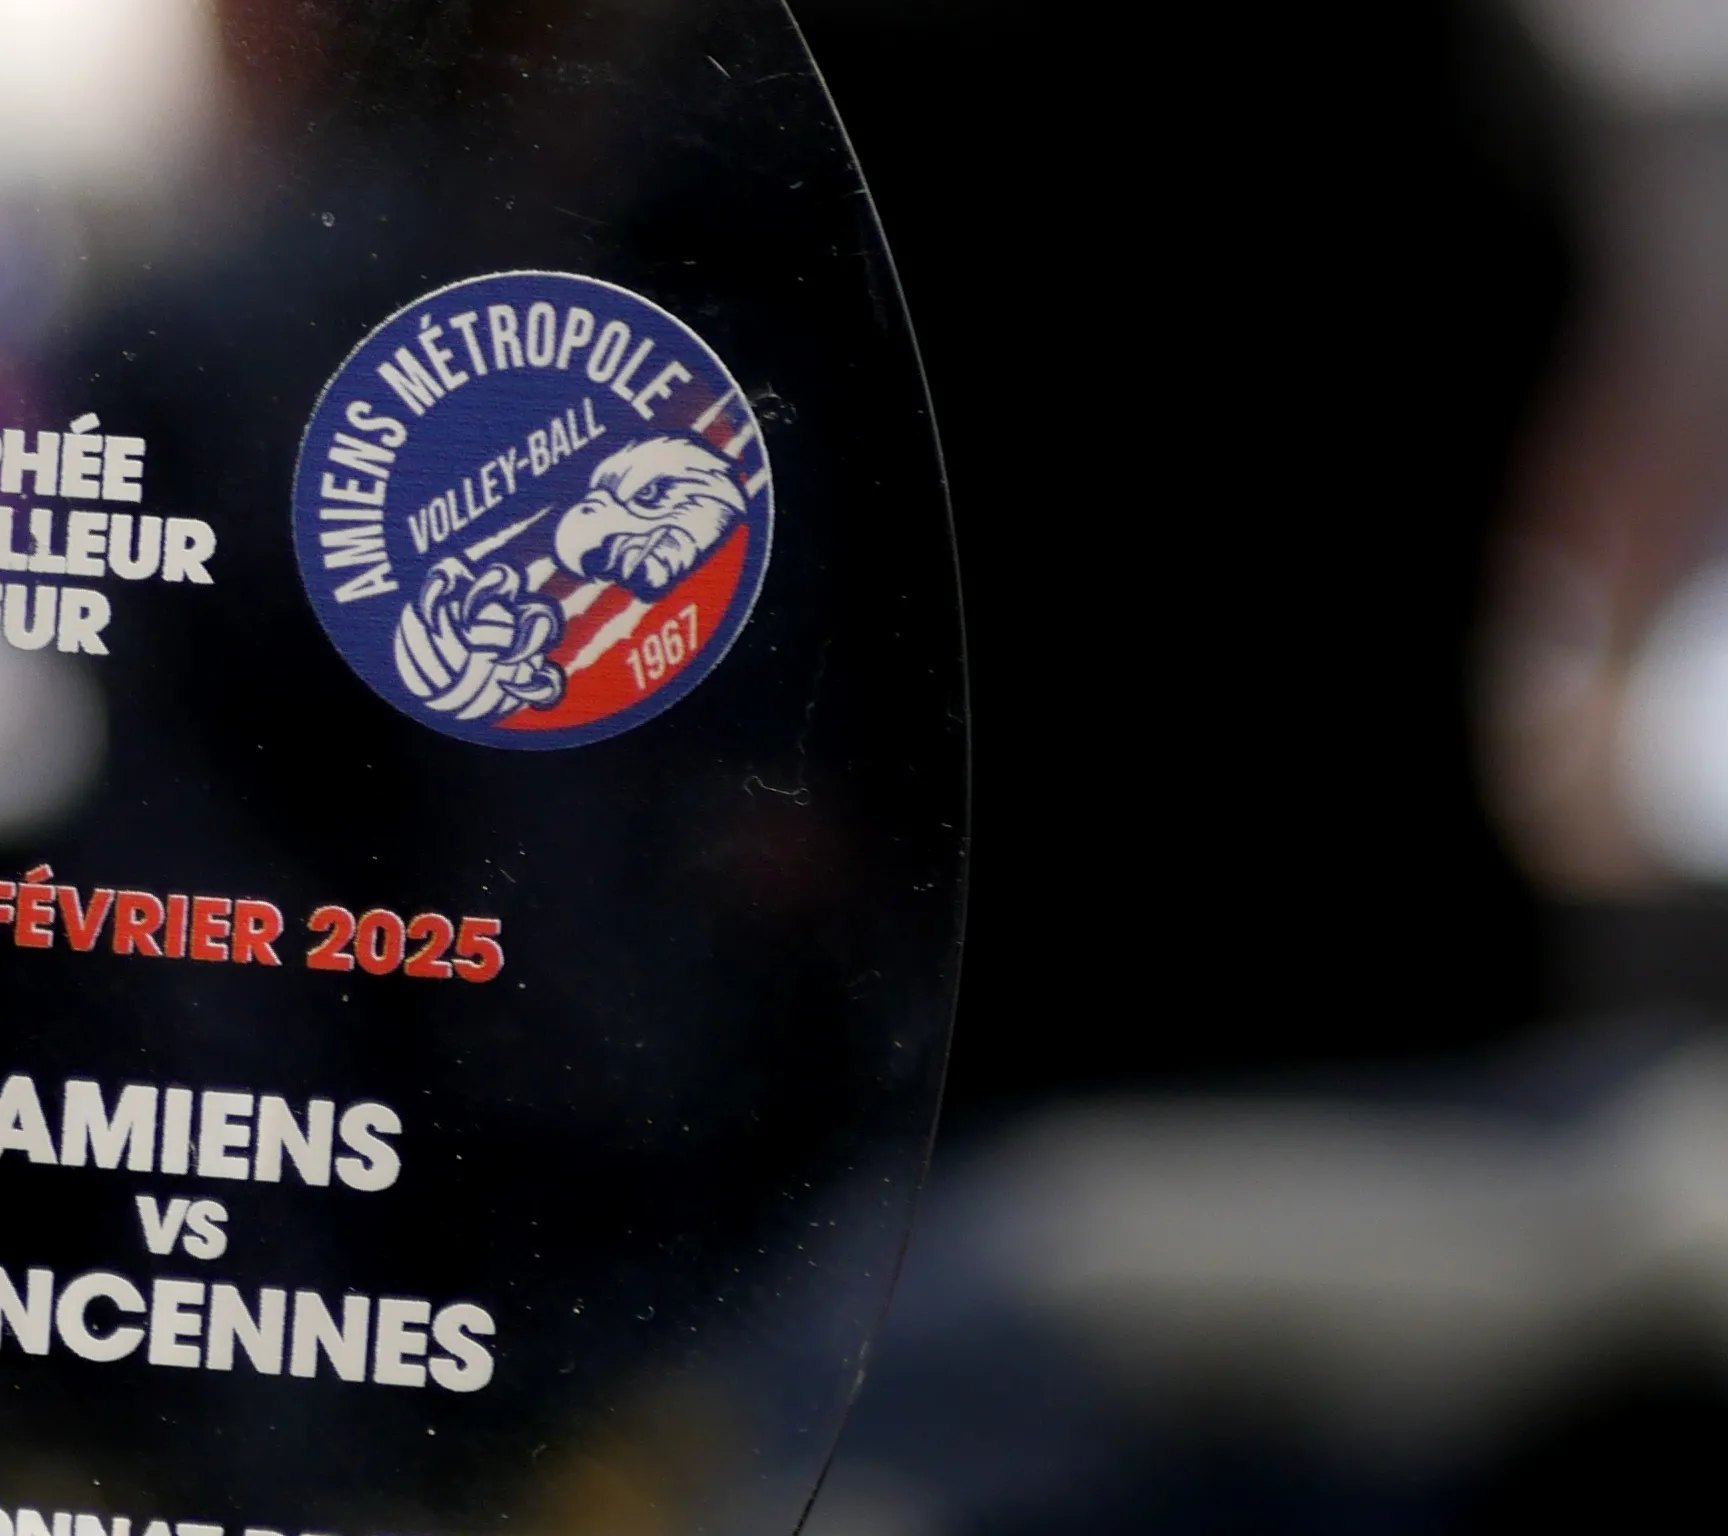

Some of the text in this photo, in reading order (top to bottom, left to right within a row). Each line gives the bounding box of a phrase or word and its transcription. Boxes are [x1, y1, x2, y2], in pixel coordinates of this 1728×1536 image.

[320, 301, 693, 604] AMIENS MÉTROPOLE
[407, 396, 607, 554] VOLLEY-BALL
[625, 603, 700, 691] 1967
[306, 905, 505, 984] 2025
[134, 1194, 229, 1261] VS
